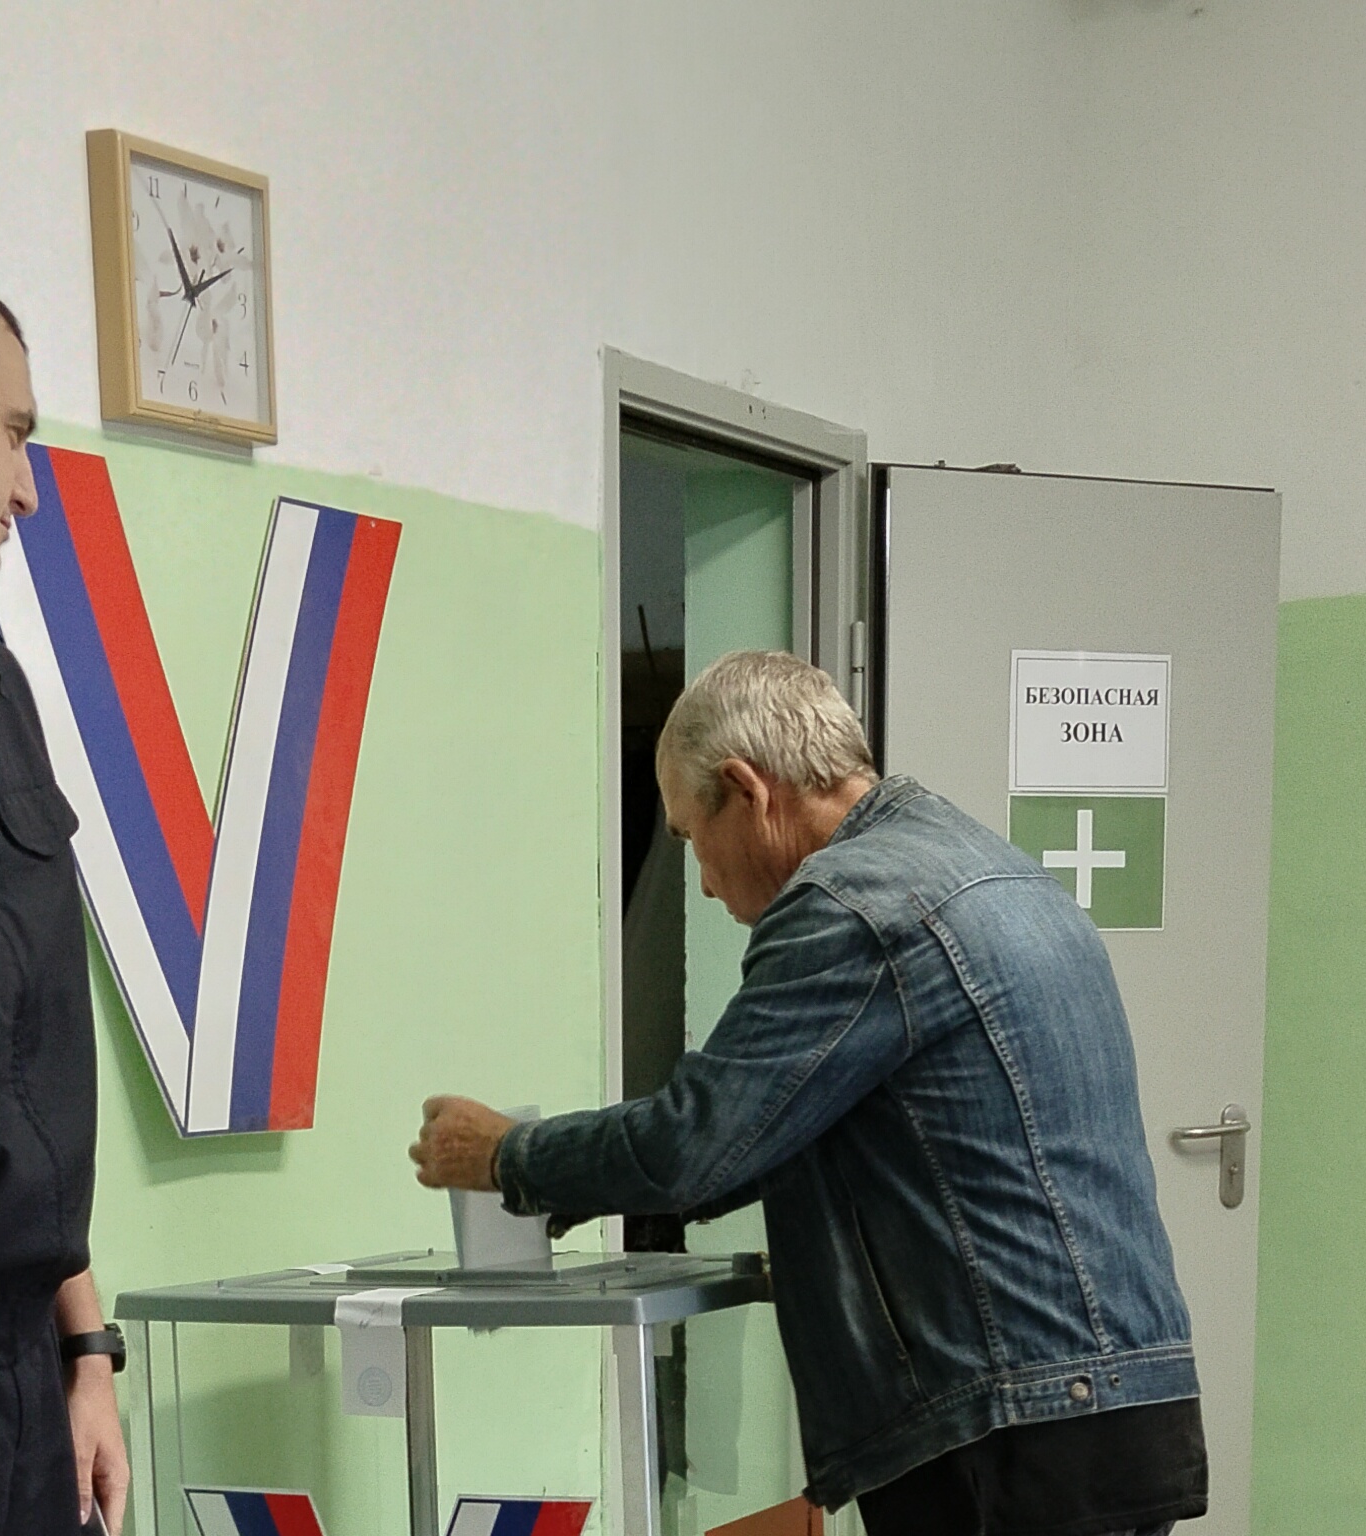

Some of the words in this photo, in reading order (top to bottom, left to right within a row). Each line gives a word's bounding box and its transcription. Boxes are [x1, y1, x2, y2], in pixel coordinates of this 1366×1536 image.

[148, 176, 160, 199] 11
[238, 293, 247, 320] 3
[188, 380, 198, 402] 6
[1025, 686, 1160, 706] БЕЗОПАСНАЯ
[1060, 722, 1124, 743] ЗОНА
